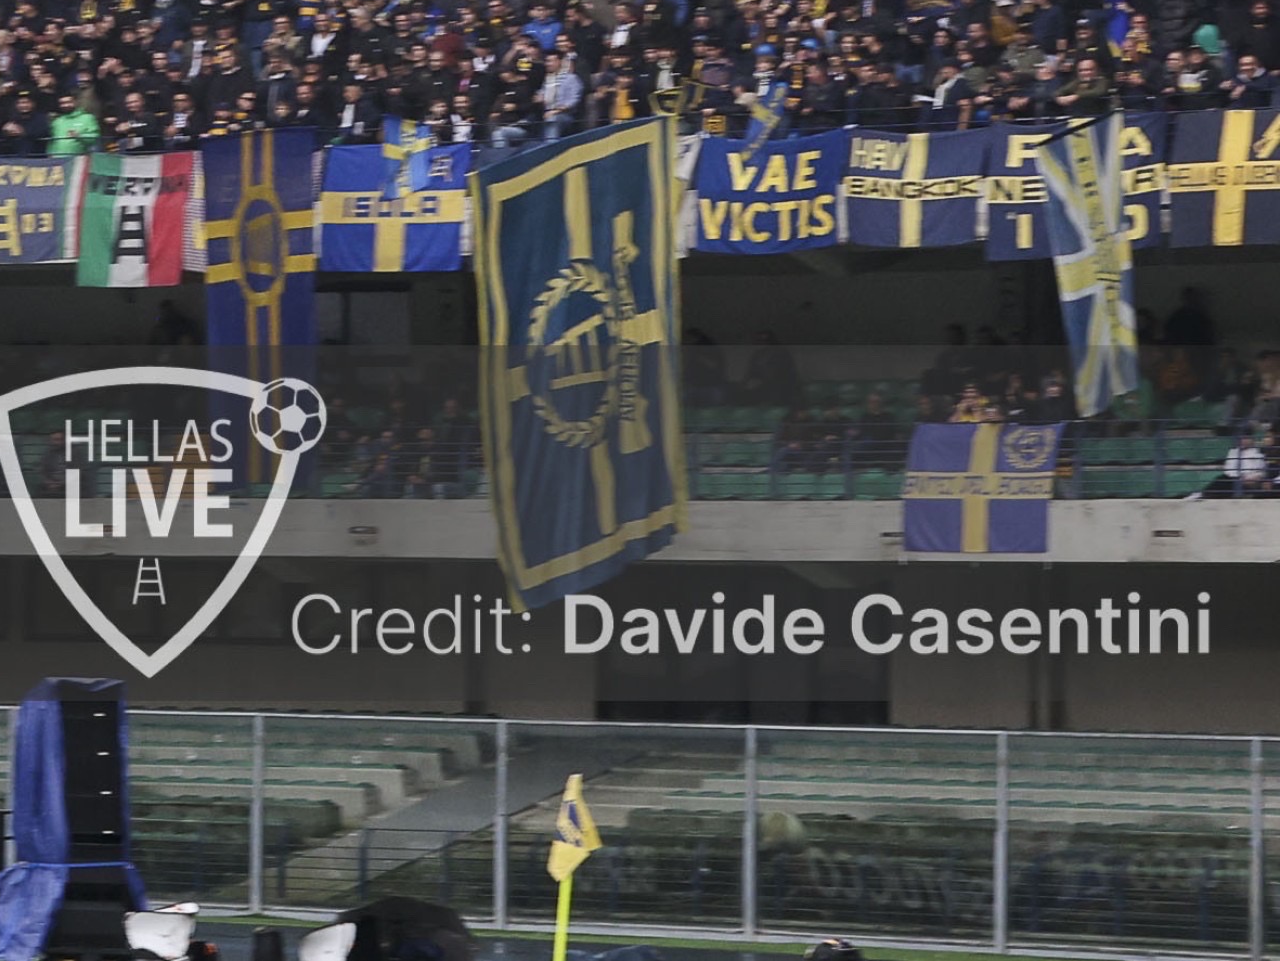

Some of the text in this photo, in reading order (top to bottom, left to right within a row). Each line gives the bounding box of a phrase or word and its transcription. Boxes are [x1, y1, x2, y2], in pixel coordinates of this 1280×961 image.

[726, 150, 821, 193] VAE
[849, 177, 983, 199] BANGKOK
[699, 194, 835, 242] VICTIS
